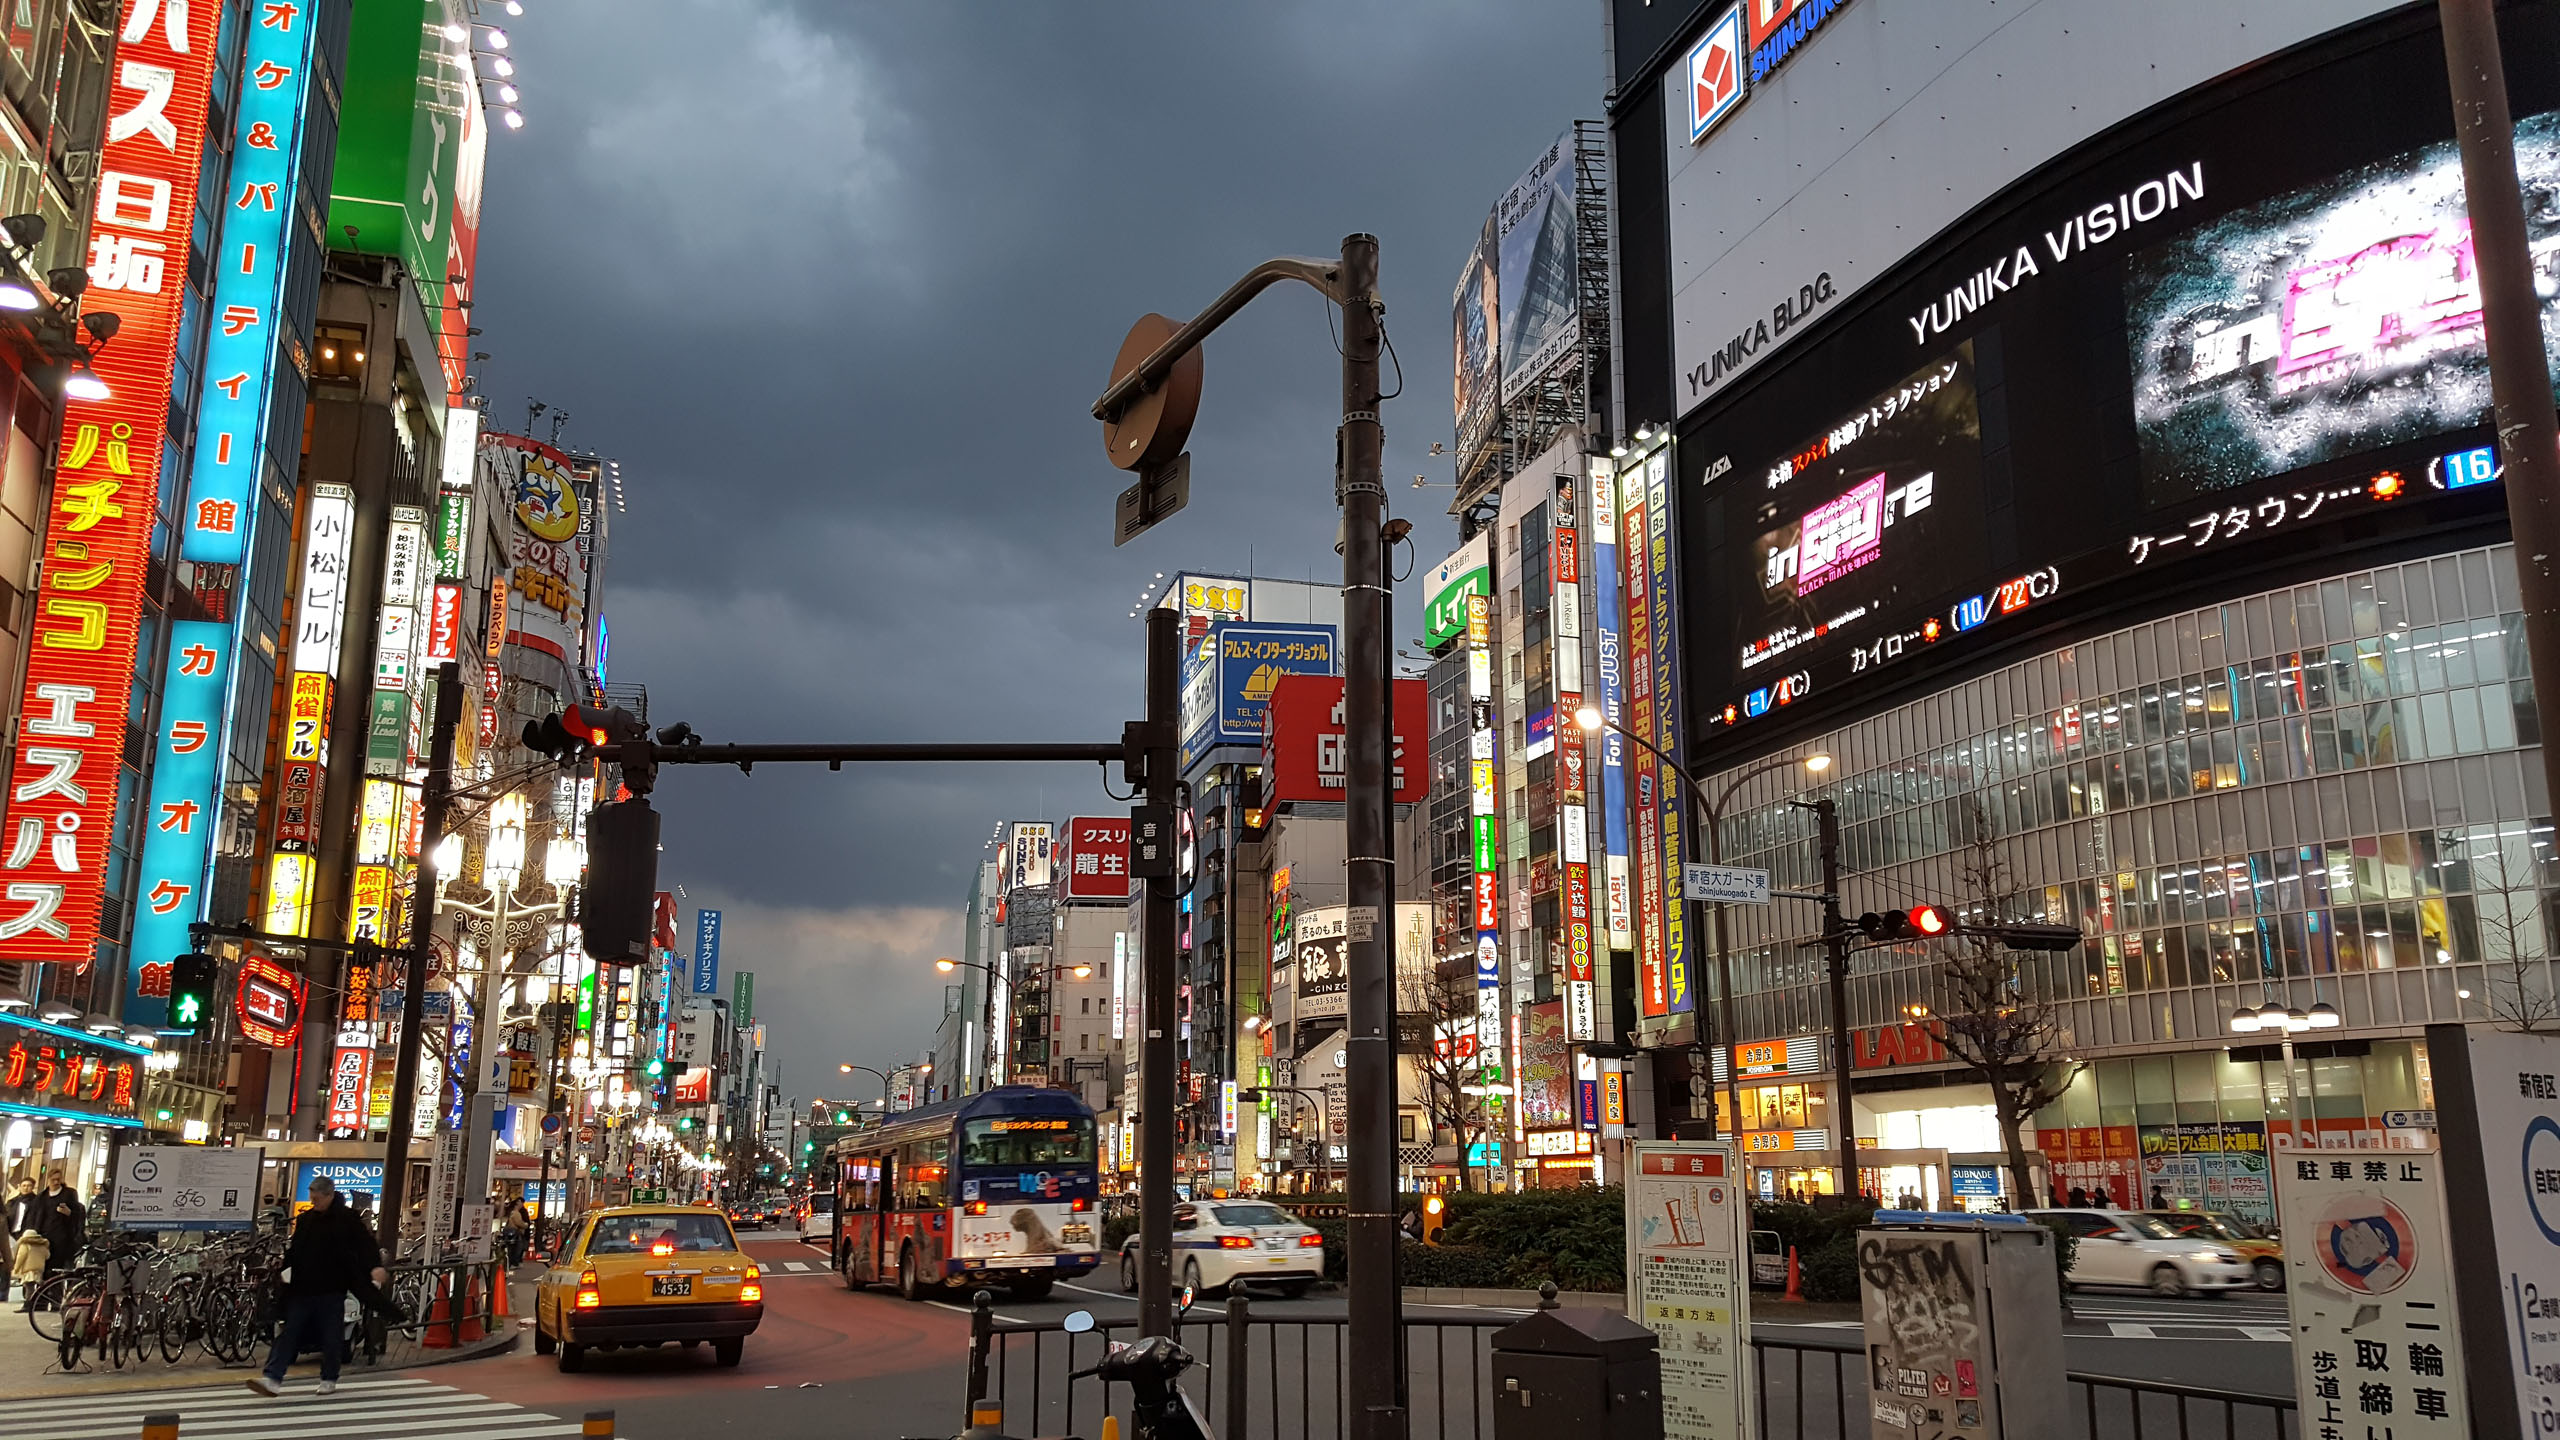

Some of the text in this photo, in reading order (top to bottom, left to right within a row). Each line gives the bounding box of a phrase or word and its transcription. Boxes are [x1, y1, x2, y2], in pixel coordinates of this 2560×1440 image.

[1752, 0, 1844, 82] SHINJUK
[1909, 161, 2206, 346] YUNIKA VISION
[1687, 270, 1839, 397] YUNIKA BLDG.
[1503, 323, 1578, 397] 不動産は株式会社TFC
[1765, 360, 1959, 490] 本格スパイ体験アトラクション
[1703, 454, 1733, 486] LISA
[1595, 475, 1606, 509] LABI
[1625, 484, 1643, 504] LABI
[1652, 488, 1664, 508] B1
[394, 508, 421, 522] 小松ビル
[1652, 514, 1665, 533] B2
[42, 421, 133, 652] パチンコ
[1629, 511, 1644, 599] 欢迎光临
[302, 514, 341, 646] 小松ビル
[389, 596, 409, 605] 2F
[1185, 583, 1246, 612] 389
[432, 601, 455, 658] アイフル
[1815, 623, 1829, 638] spy
[1224, 640, 1329, 662] アムス・インターナショナル
[1599, 629, 1622, 767] For Your JUST
[1631, 597, 1653, 773] TAX FREE
[1561, 697, 1581, 706] FAST
[290, 674, 323, 759] 麻雀ブル
[1562, 728, 1582, 737] FAST
[1563, 735, 1582, 745] NAIL
[372, 762, 392, 774] 3F
[1568, 749, 1580, 790] マツエク
[282, 765, 312, 824] 居酒屋
[0, 682, 97, 943] エスパス
[137, 643, 219, 998] カラオケ館
[281, 838, 302, 851] 4F
[1037, 837, 1048, 859] NEW
[1142, 822, 1158, 860] 音響
[1015, 837, 1028, 887] SUNPARK
[1074, 852, 1126, 876] 龍生
[1570, 866, 1587, 919] 飲み放題
[1688, 869, 1766, 890] 新宿大ガード東
[1698, 886, 1748, 899] Shinjukuogado
[353, 867, 384, 940] 麻雀ブル
[1478, 874, 1495, 927] アイフル
[1611, 876, 1621, 914] LABI
[1301, 919, 1347, 940] 売るのも買
[699, 924, 716, 993] オザキクリニック
[1479, 991, 1499, 1046] 大勝軒
[345, 1034, 361, 1044] 8F
[1854, 1021, 1944, 1069] LABI
[1745, 1046, 1773, 1064] 吉野家
[334, 1052, 363, 1113] 居酒屋
[2517, 1071, 2558, 1100] 新宿区
[1583, 1083, 1594, 1121] PROMISE
[1607, 1077, 1621, 1120] 吉野家
[1765, 1092, 1801, 1109] 2F 客席
[331, 1112, 358, 1125] 本陣
[2394, 1115, 2406, 1124] 302
[333, 1128, 353, 1139] 4F
[1752, 1134, 1780, 1150] 吉野家
[1660, 1156, 1705, 1174] 警告
[1953, 1169, 1993, 1179] SUBNADE
[2296, 1160, 2424, 1183] 駐車禁止
[528, 1182, 566, 1191] SUNAD
[635, 1189, 664, 1201] 平和
[660, 1283, 690, 1296] 45-32
[1660, 1307, 1716, 1322] 返還方法
[2405, 1301, 2450, 1421] 二輪車
[1897, 1368, 1928, 1386] PILFER
[2353, 1338, 2394, 1440] 取締り
[1876, 1399, 1906, 1414] SOWN
